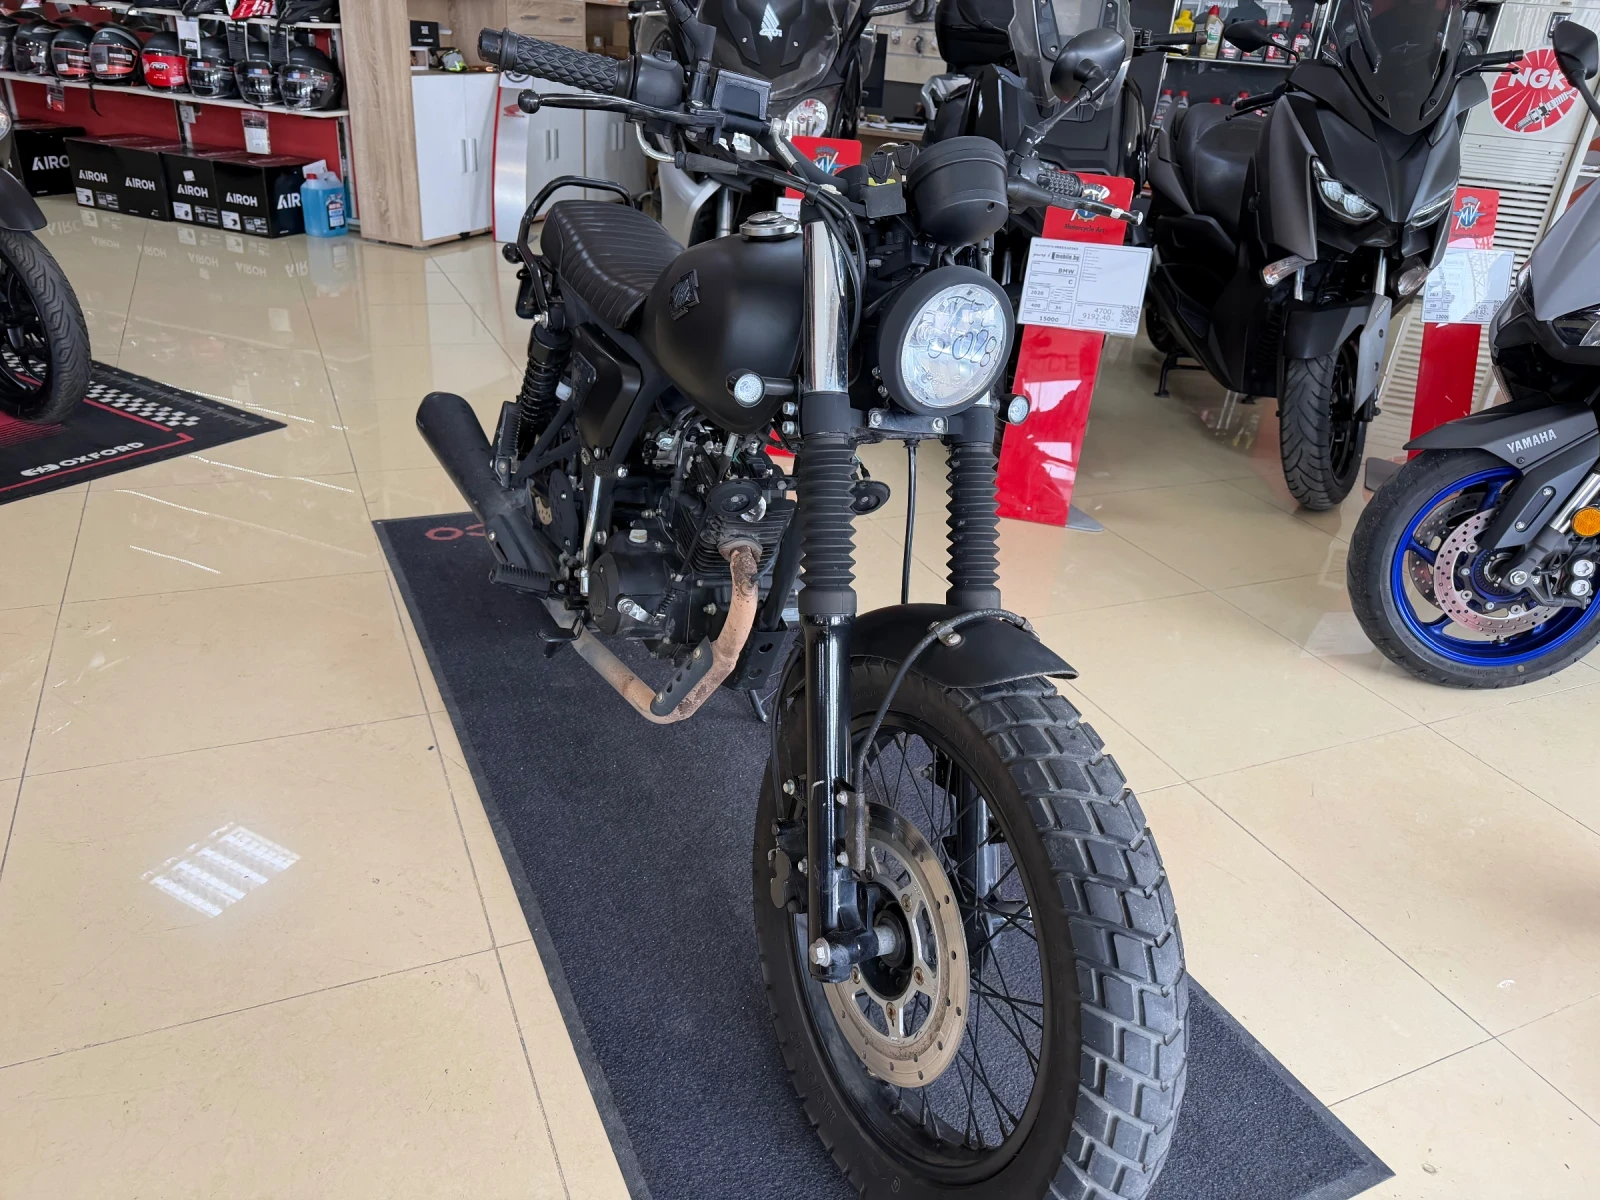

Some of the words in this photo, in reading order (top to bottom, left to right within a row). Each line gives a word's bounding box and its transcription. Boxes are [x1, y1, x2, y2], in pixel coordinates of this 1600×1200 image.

[1508, 67, 1566, 91] NGK
[79, 169, 109, 184] AIROH
[125, 176, 156, 191] AIROH
[177, 184, 209, 199] AIROH
[226, 192, 258, 208] AIROH
[1063, 223, 1095, 232] Motorcycle
[1055, 253, 1080, 262] mobile.bg
[1039, 315, 1059, 323] 15000
[1506, 428, 1558, 454] YAMAHA
[59, 441, 145, 467] OXFORD
